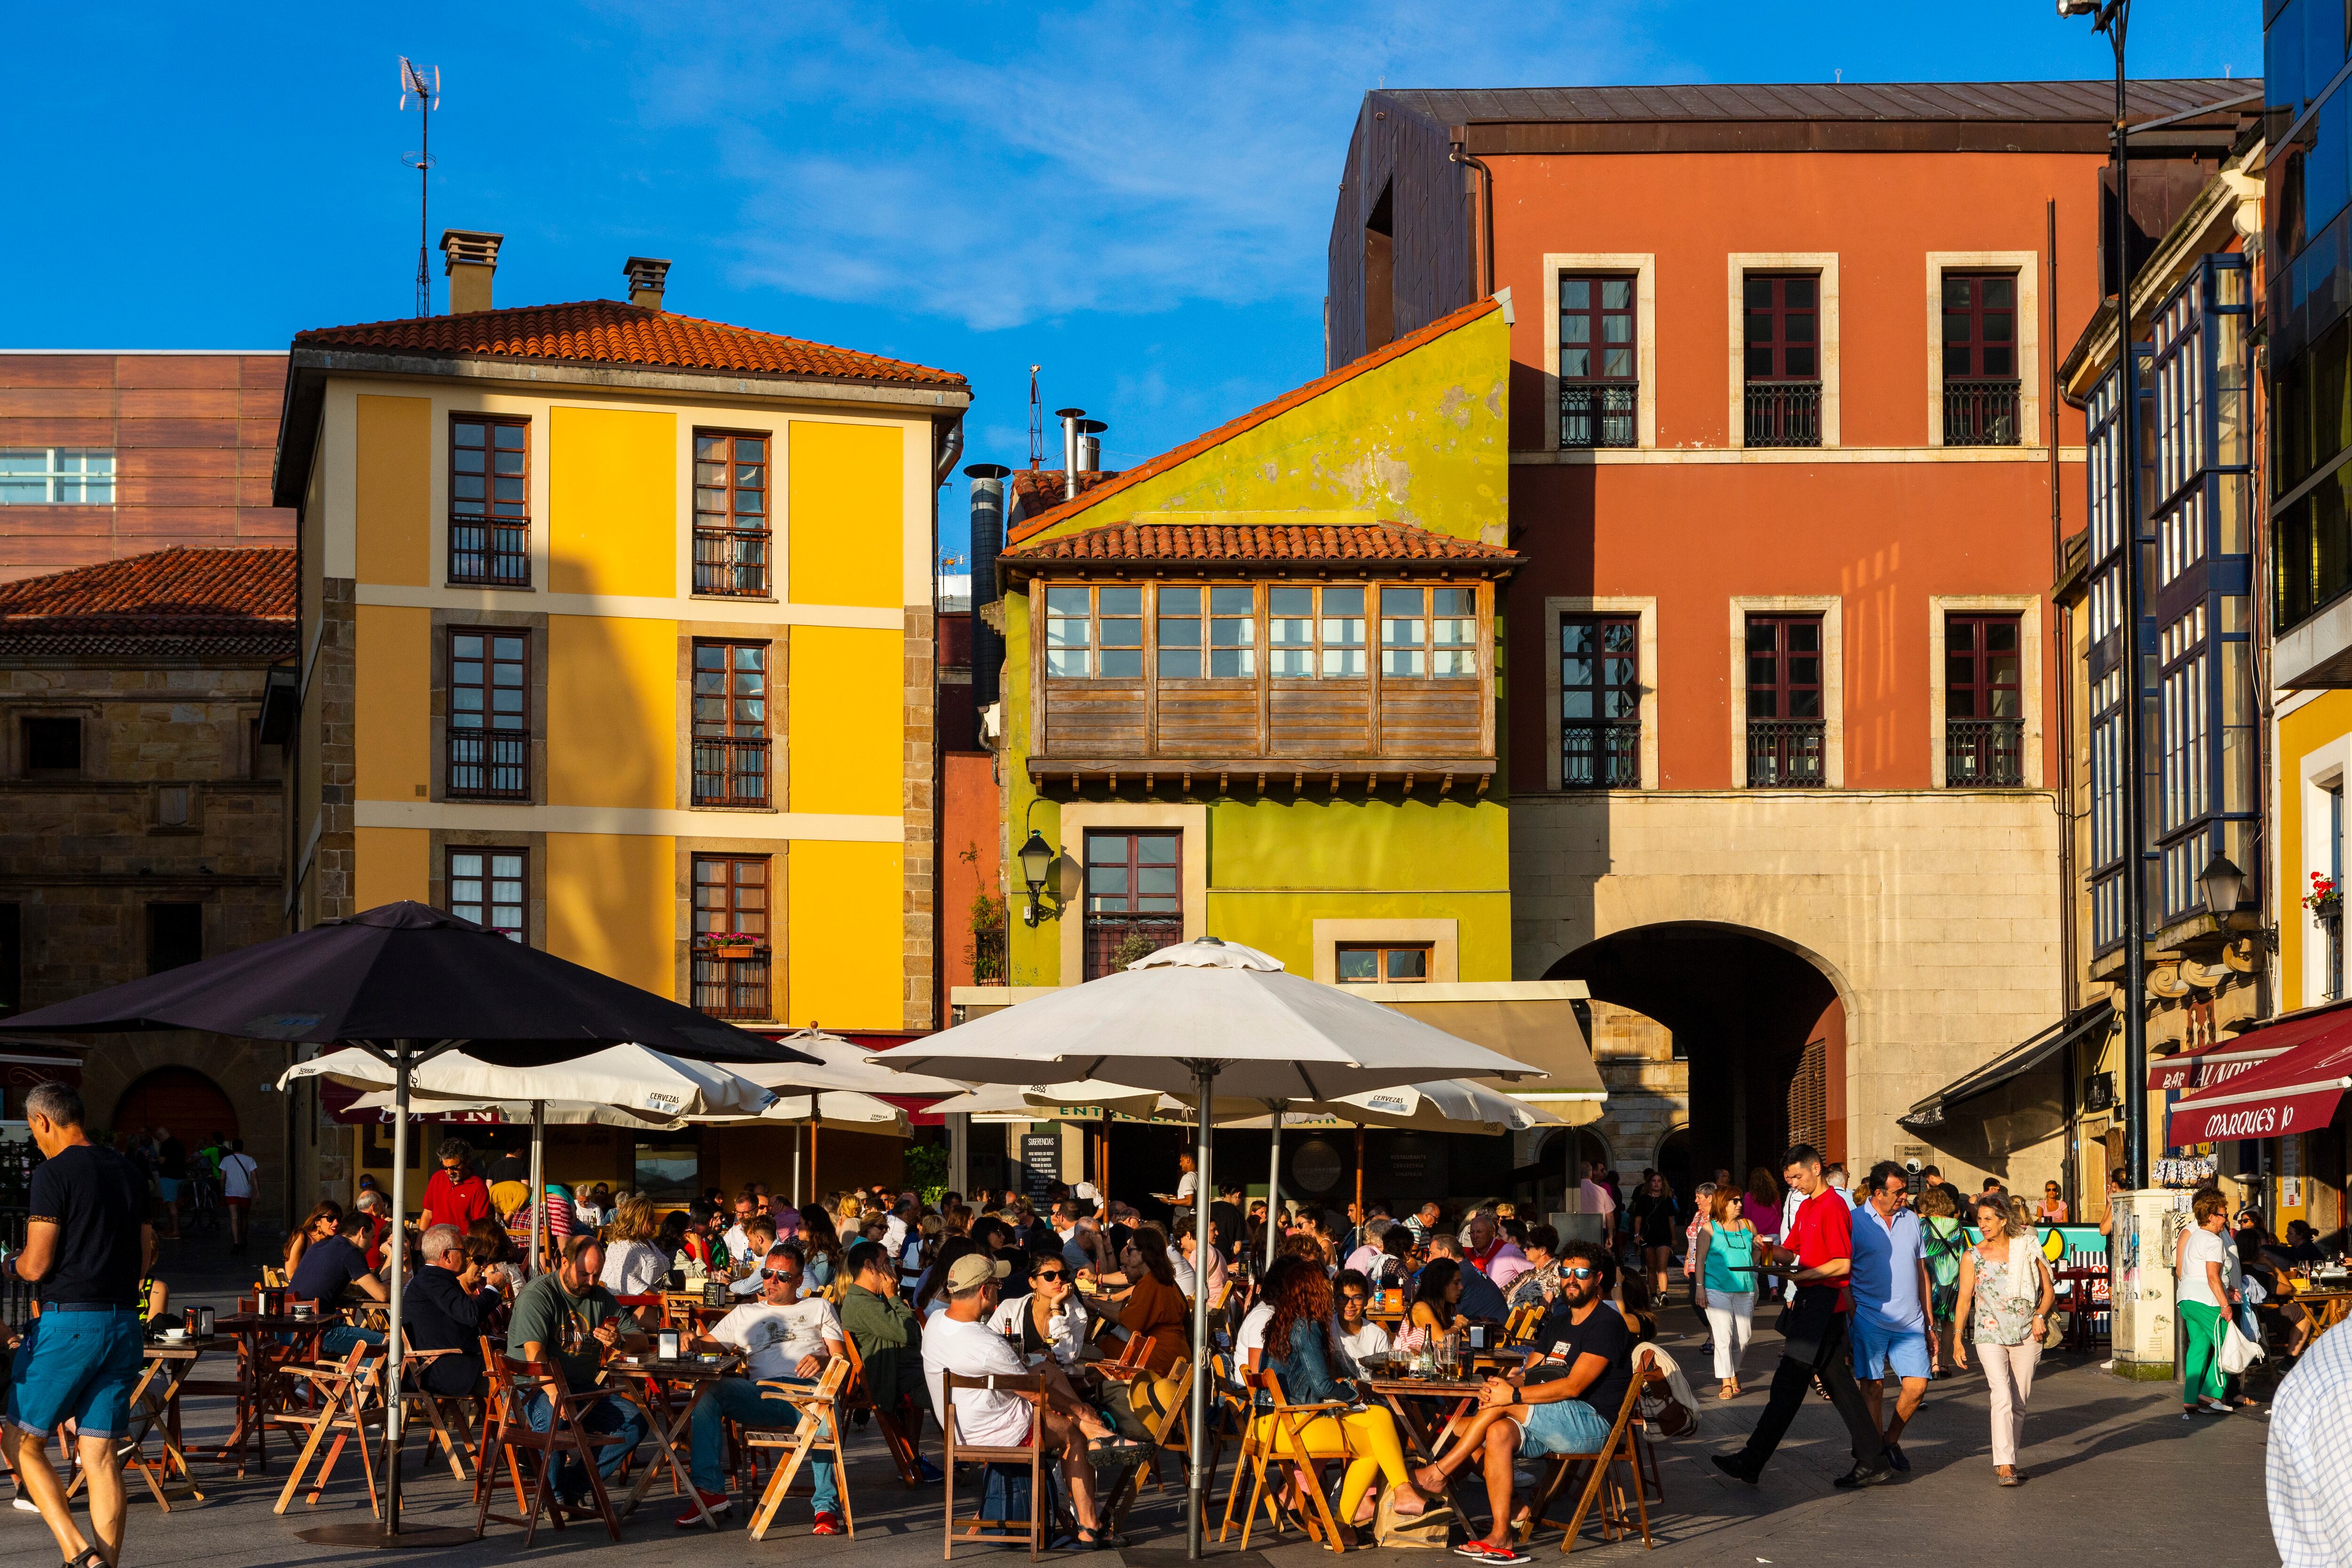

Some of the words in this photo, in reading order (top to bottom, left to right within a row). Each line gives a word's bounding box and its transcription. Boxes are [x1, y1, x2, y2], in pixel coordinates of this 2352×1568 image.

[2162, 1071, 2185, 1089] BAR
[2193, 1065, 2214, 1087] AL
[650, 1092, 679, 1104] CERVEZAS
[1373, 1095, 1403, 1104] CERVEZAS
